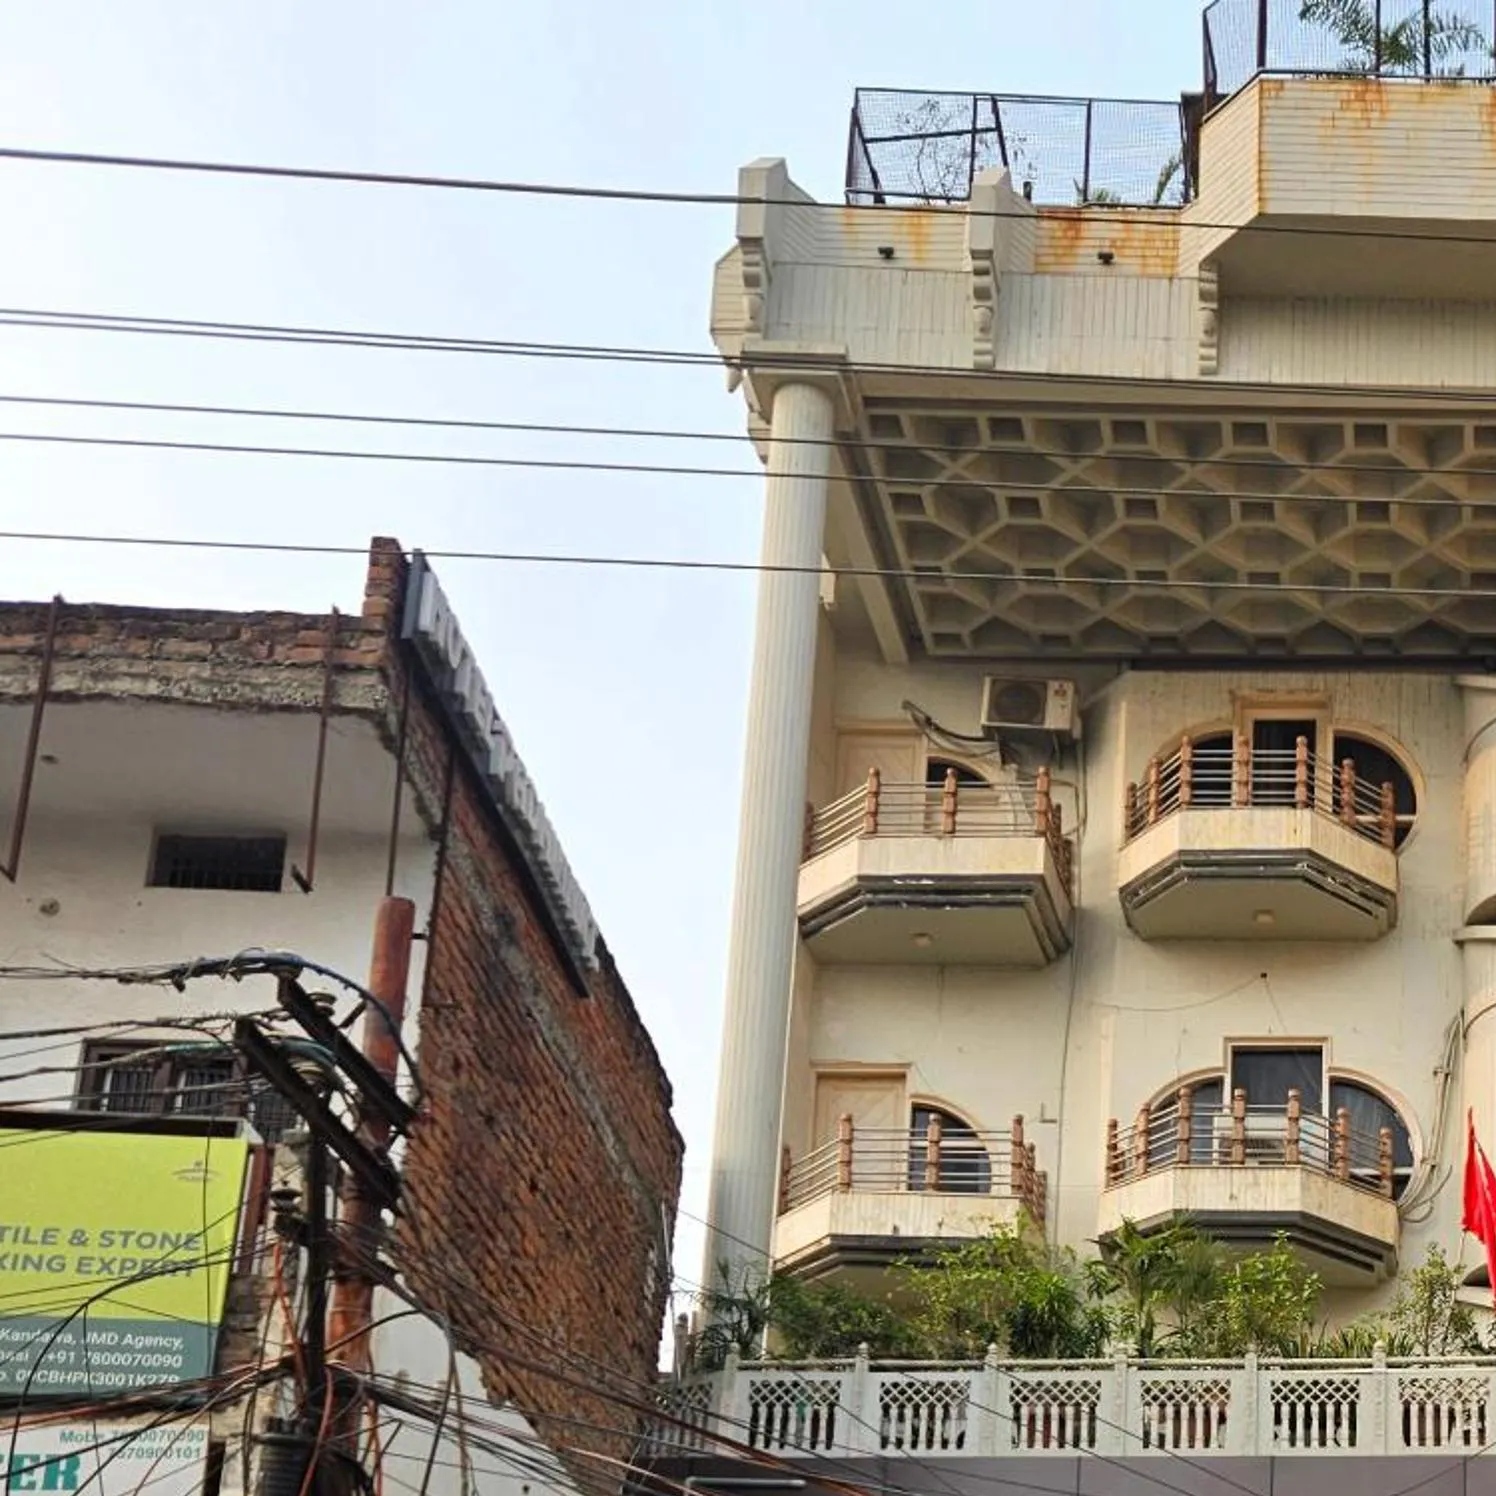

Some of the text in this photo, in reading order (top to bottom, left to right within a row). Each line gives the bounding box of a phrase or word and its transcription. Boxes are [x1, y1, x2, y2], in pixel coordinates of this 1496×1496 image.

[68, 1229, 89, 1246] &
[98, 1231, 202, 1251] STONE
[122, 1333, 185, 1350] Agency,
